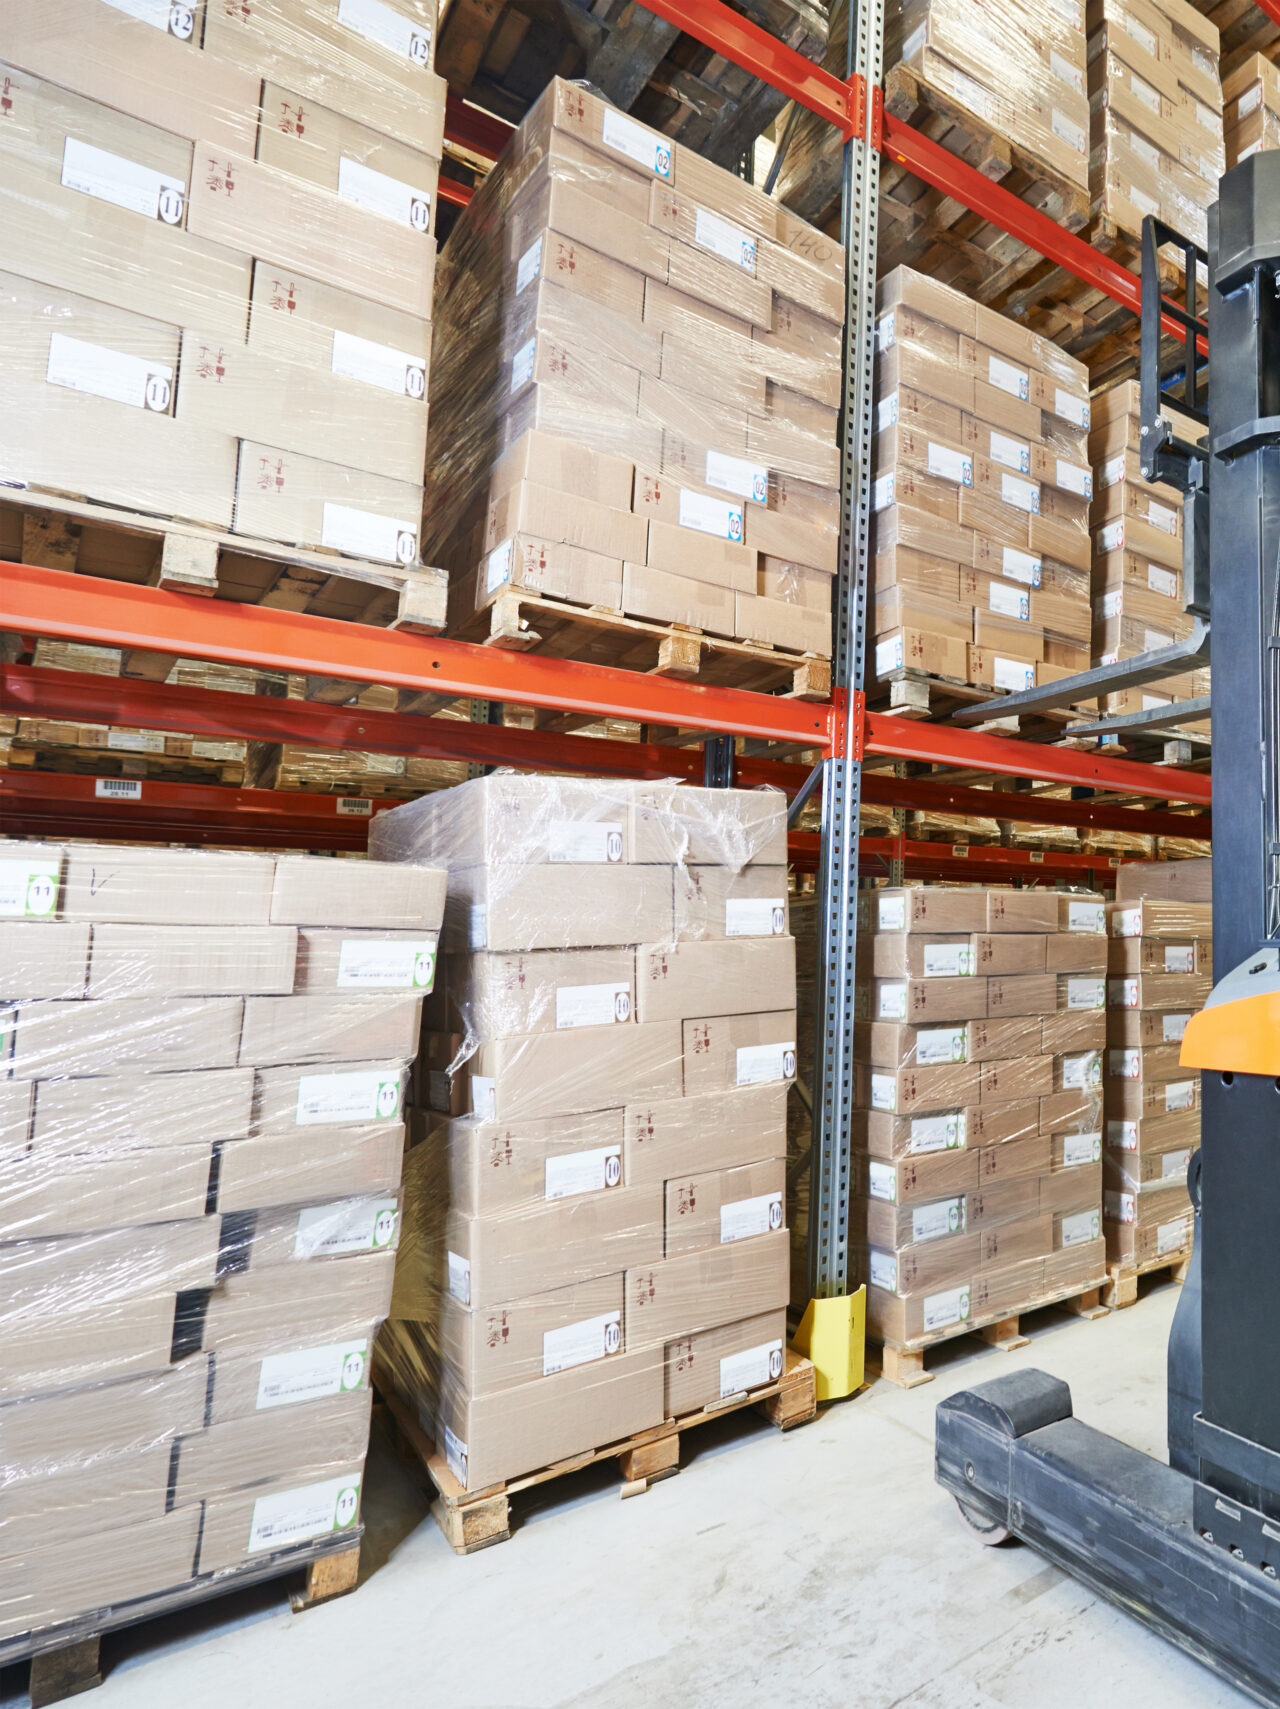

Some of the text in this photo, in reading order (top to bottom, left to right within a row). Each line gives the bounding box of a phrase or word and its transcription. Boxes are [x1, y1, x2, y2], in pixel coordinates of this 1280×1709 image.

[174, 9, 190, 31] 12
[414, 40, 427, 59] 12
[658, 153, 669, 170] 02
[165, 196, 179, 217] 11
[415, 206, 426, 225] 11
[410, 373, 422, 391] 11
[152, 383, 166, 404] 11
[756, 480, 765, 496] 02
[730, 518, 739, 535] 02
[402, 540, 413, 557] 11
[34, 885, 50, 896] 11
[775, 913, 784, 928] 10
[419, 961, 430, 970] 11
[618, 998, 629, 1014] 10
[785, 1057, 794, 1072] 10
[382, 1091, 394, 1101] 11
[608, 1162, 619, 1179] 10
[772, 1208, 781, 1223] 10
[379, 1219, 390, 1230] 11
[608, 1329, 619, 1346] 10
[346, 1362, 359, 1373] 11
[772, 1356, 781, 1371] 10
[341, 1497, 354, 1508] 11
